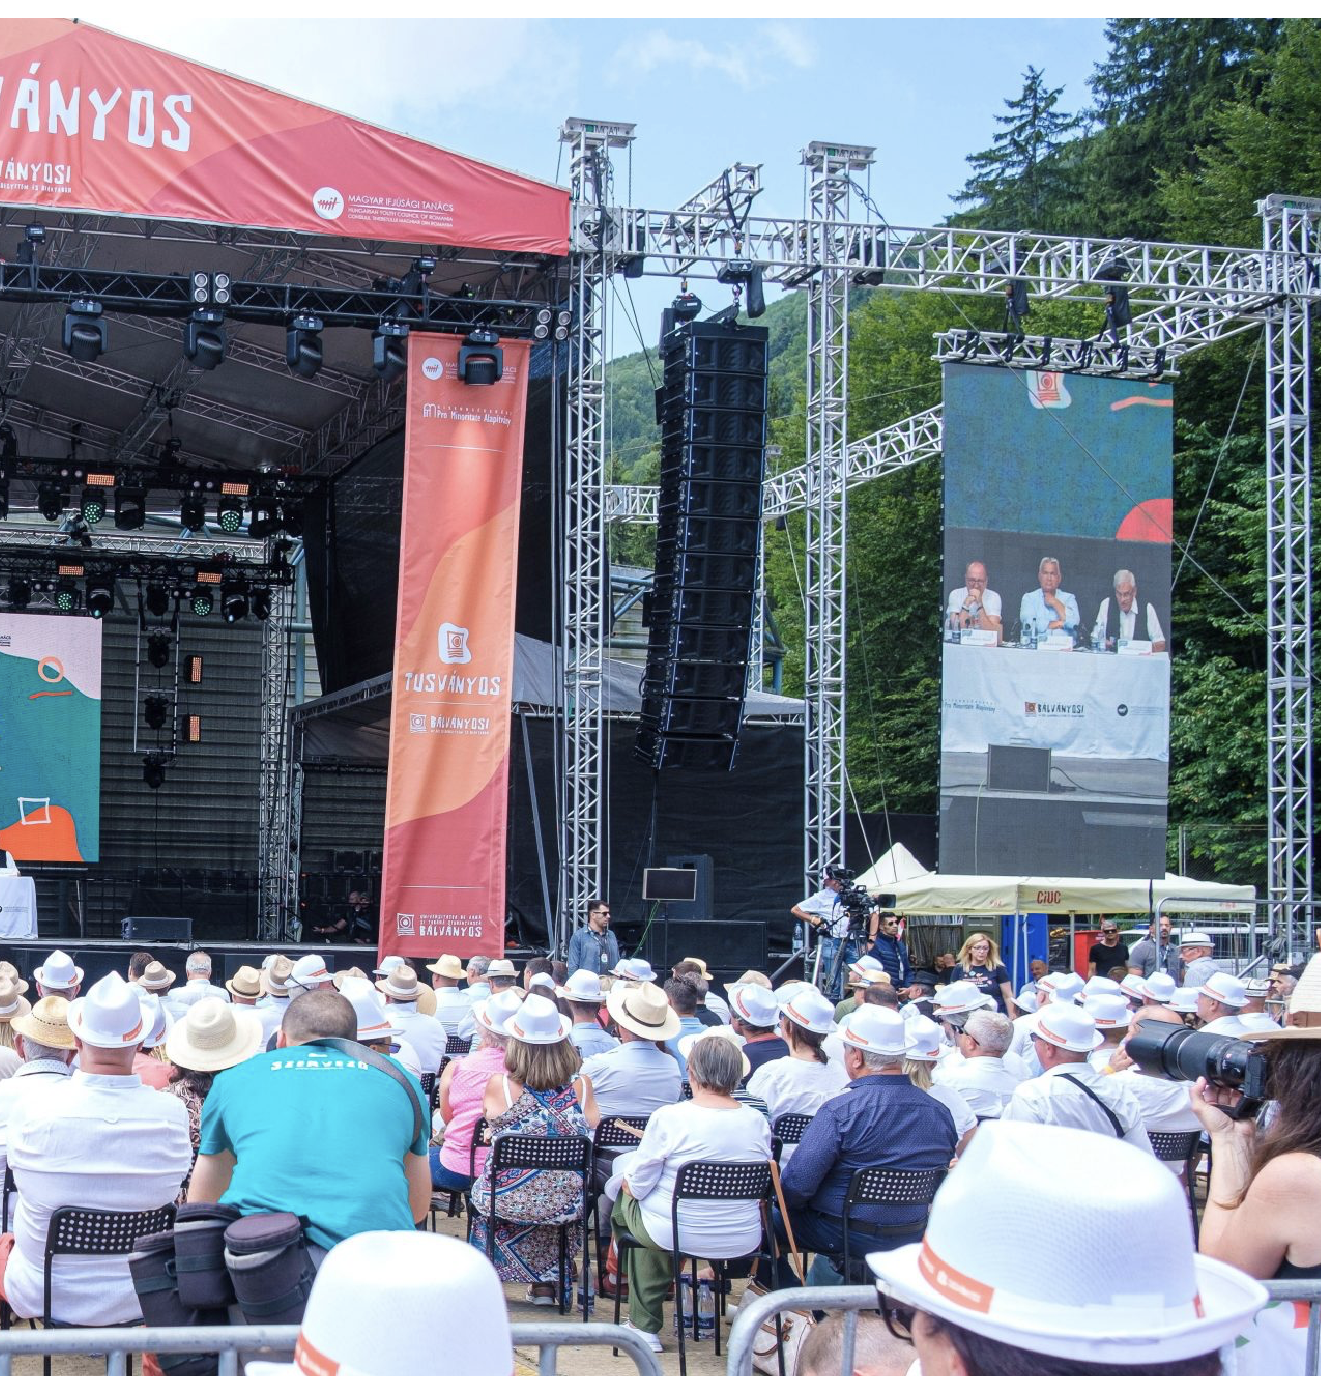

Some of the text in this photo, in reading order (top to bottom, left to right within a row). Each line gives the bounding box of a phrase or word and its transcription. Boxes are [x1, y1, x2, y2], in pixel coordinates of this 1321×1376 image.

[348, 194, 384, 204] MAGYAR
[422, 199, 454, 212] TANÁCS
[404, 670, 501, 696] TUSVÁNYOS
[419, 925, 483, 938] BÁLVÁNYOS
